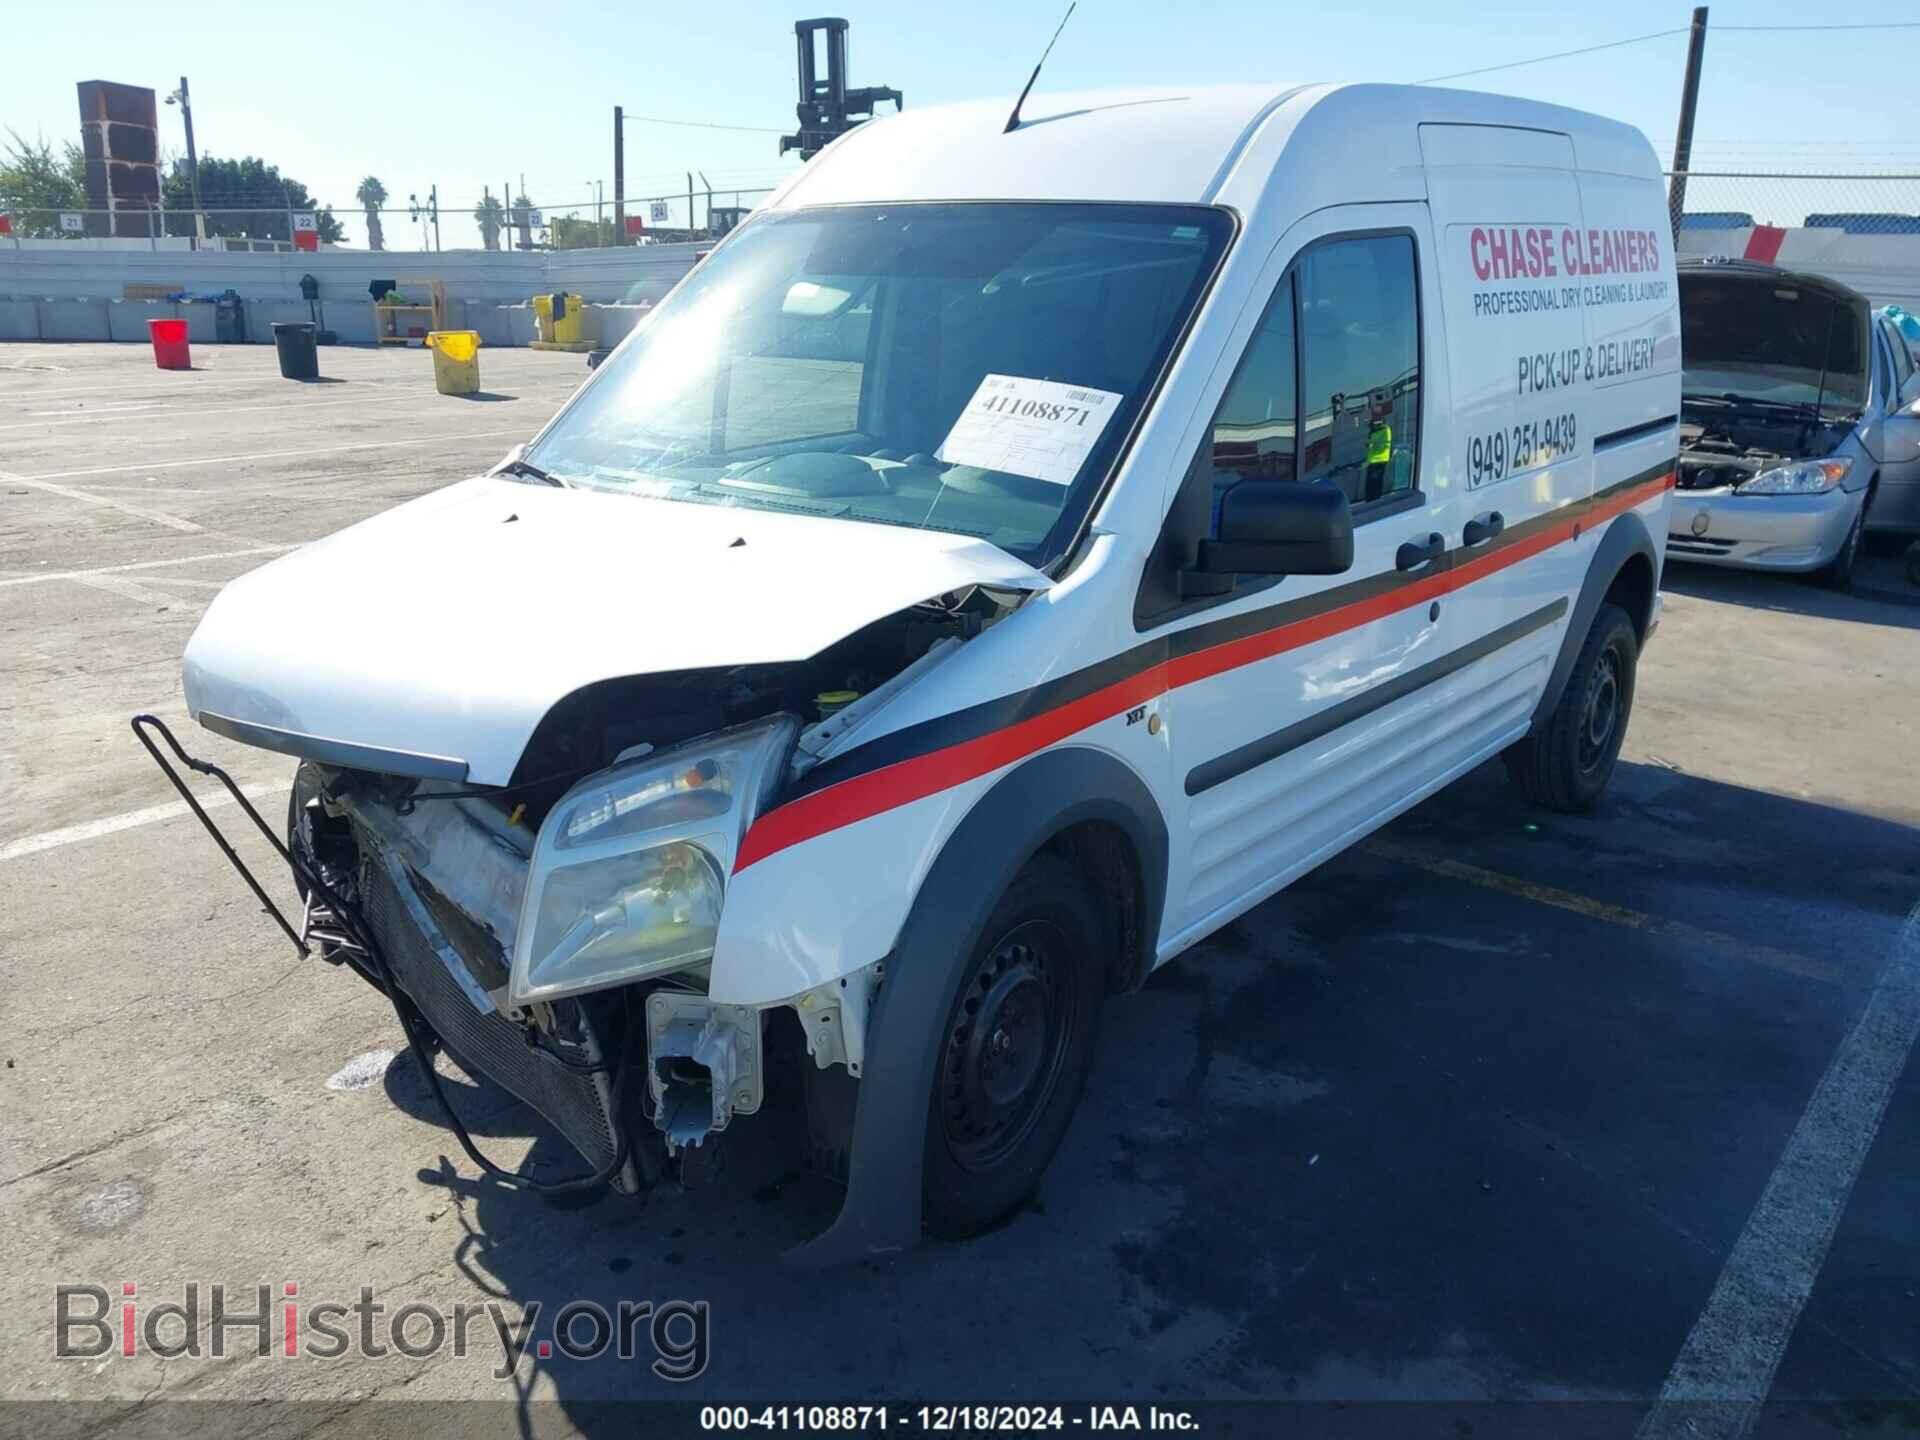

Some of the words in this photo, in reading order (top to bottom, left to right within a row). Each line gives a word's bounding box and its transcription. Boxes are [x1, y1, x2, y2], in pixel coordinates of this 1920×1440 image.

[299, 217, 311, 227] 22
[1471, 227, 1557, 281] CHASE
[1561, 228, 1660, 276] CLEANERS
[1474, 287, 1560, 316] PROFESSIONAL
[1561, 287, 1581, 309] DRY
[1584, 283, 1626, 307] CLEANING
[1635, 281, 1669, 301] LAUNDRY
[1518, 349, 1580, 395] PICK-UP
[1584, 346, 1594, 381] &
[1597, 336, 1656, 378] DELIVERY
[982, 394, 1091, 427] 41108871
[1466, 427, 1510, 491] (949)
[1512, 412, 1576, 469] 251-9439
